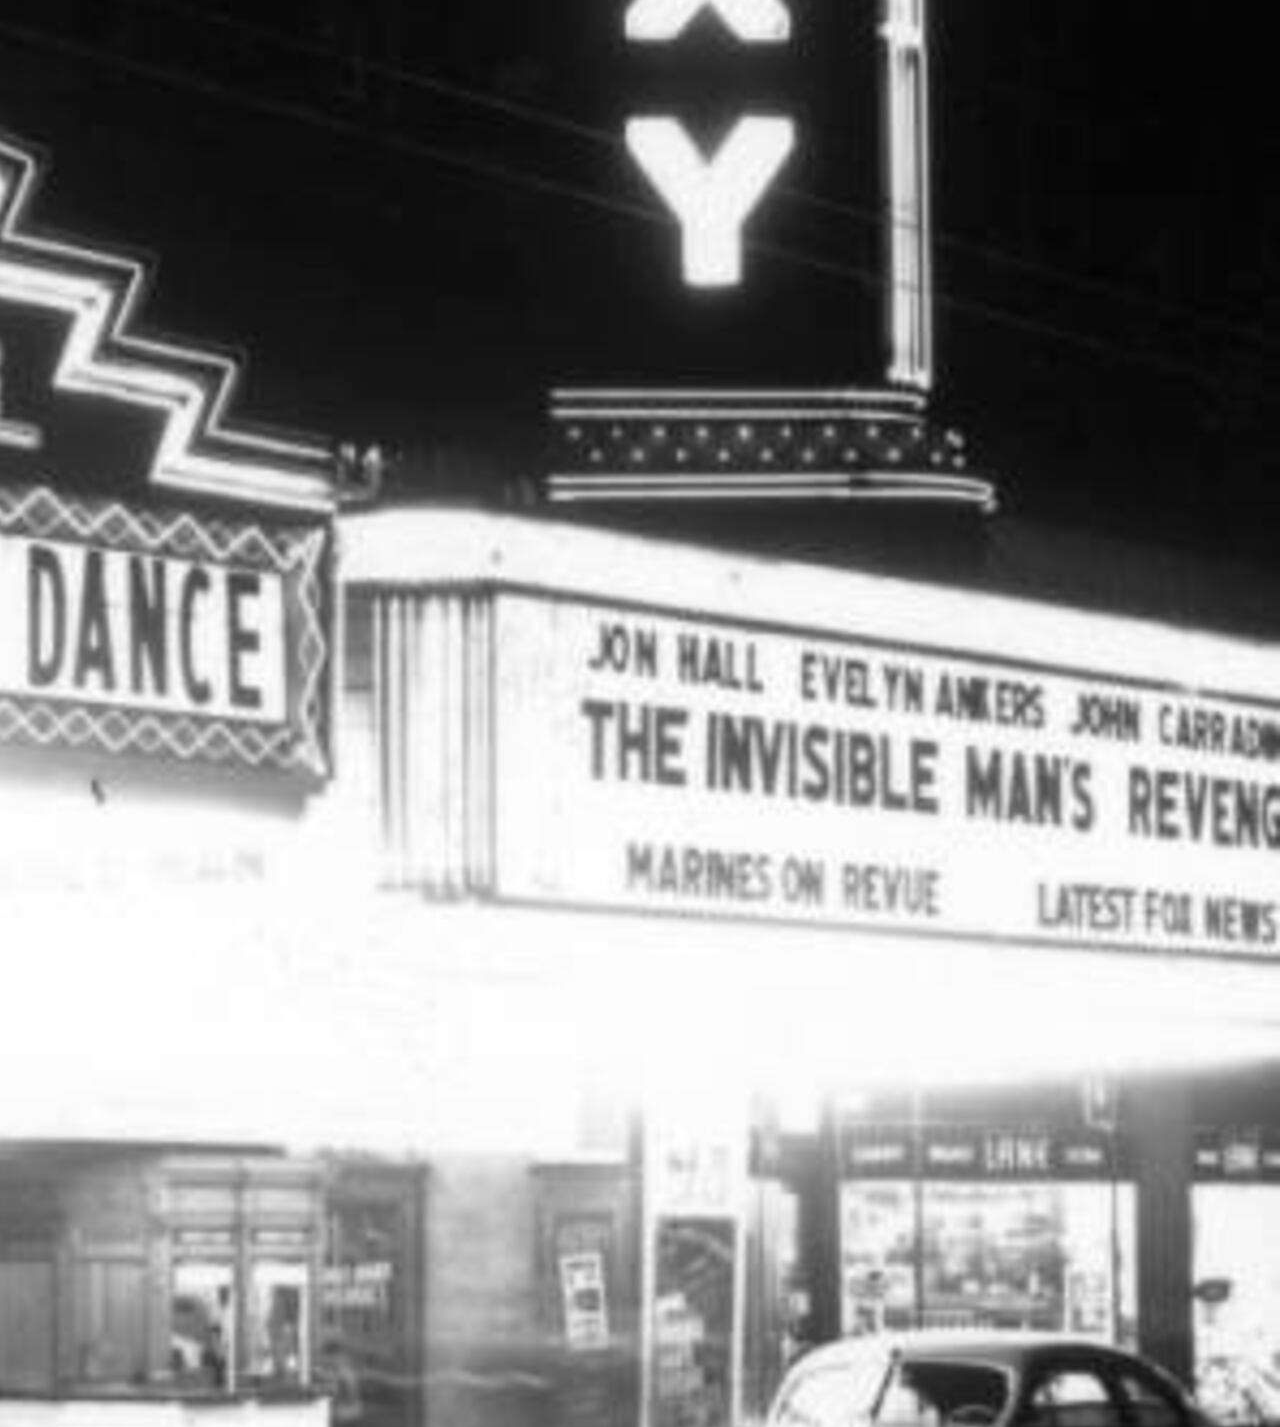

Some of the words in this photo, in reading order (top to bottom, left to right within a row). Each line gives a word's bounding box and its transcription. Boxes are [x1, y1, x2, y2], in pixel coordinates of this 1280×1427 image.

[27, 542, 263, 709] DANCE
[587, 621, 658, 680] JON
[676, 631, 766, 695] HALL
[800, 649, 926, 717] EVELYN
[934, 668, 1046, 732] ANKERS
[1070, 690, 1143, 746] JOHN
[580, 695, 690, 788] THE
[704, 708, 941, 817] INVISIBLE
[964, 743, 1097, 834] MAN'S
[1126, 763, 1280, 852] REVENG
[625, 840, 774, 904] MARINES
[781, 853, 826, 907] ON
[840, 861, 942, 920] REVUE
[1037, 881, 1140, 936] LATEST
[1143, 886, 1193, 938] FOX
[1203, 891, 1278, 948] NEWS
